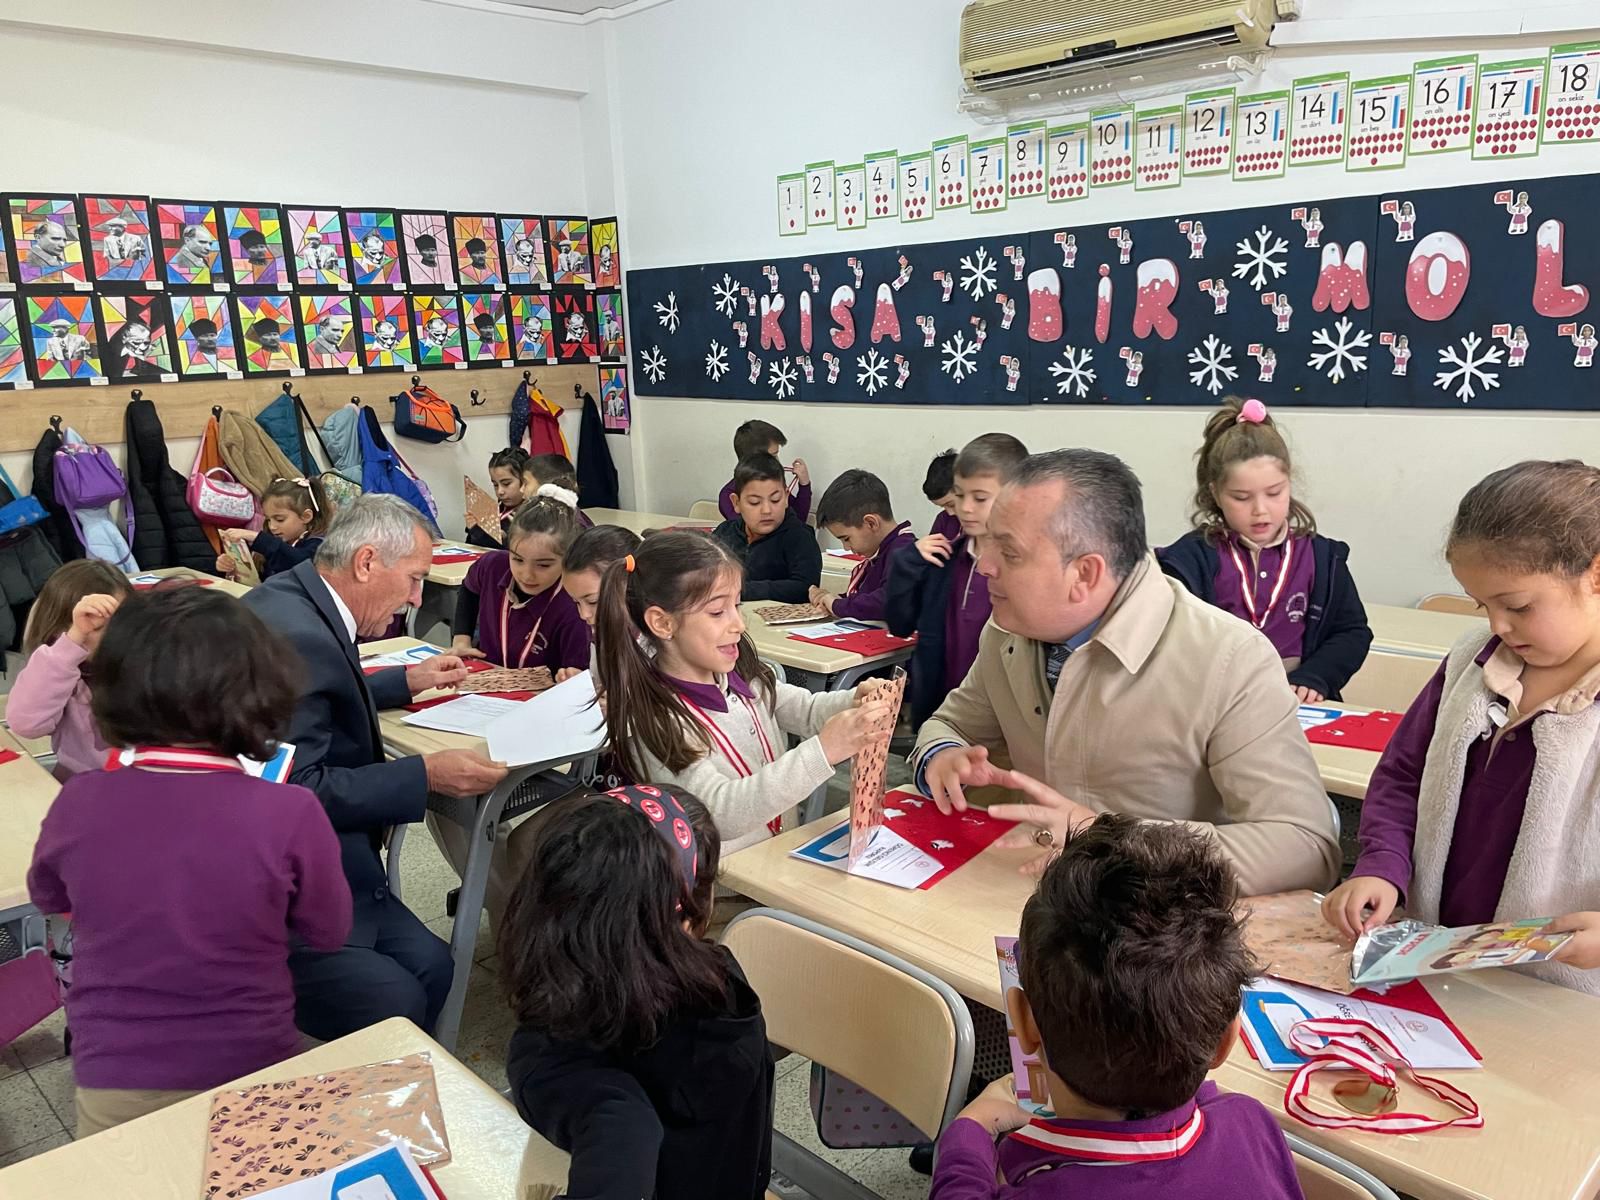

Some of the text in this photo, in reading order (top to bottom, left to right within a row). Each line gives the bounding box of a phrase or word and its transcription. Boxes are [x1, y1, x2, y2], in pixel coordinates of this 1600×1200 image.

[1561, 64, 1589, 92] 18
[1424, 78, 1450, 106] 16
[1488, 81, 1518, 109] 17
[1301, 93, 1326, 120] 14
[1360, 96, 1387, 124] 15
[1194, 108, 1215, 132] 12
[1245, 111, 1267, 136] 13
[1097, 123, 1117, 147] 10
[1146, 125, 1162, 149] 11
[1017, 139, 1027, 161] 8
[1058, 141, 1068, 164] 9
[872, 166, 882, 185] 4
[942, 153, 951, 174] 6
[978, 155, 989, 177] 7
[813, 176, 822, 194] 2
[843, 178, 852, 197] 3
[908, 168, 917, 188] 5
[786, 187, 791, 205] 1
[760, 283, 902, 353] KISA
[1027, 258, 1180, 343] BİR
